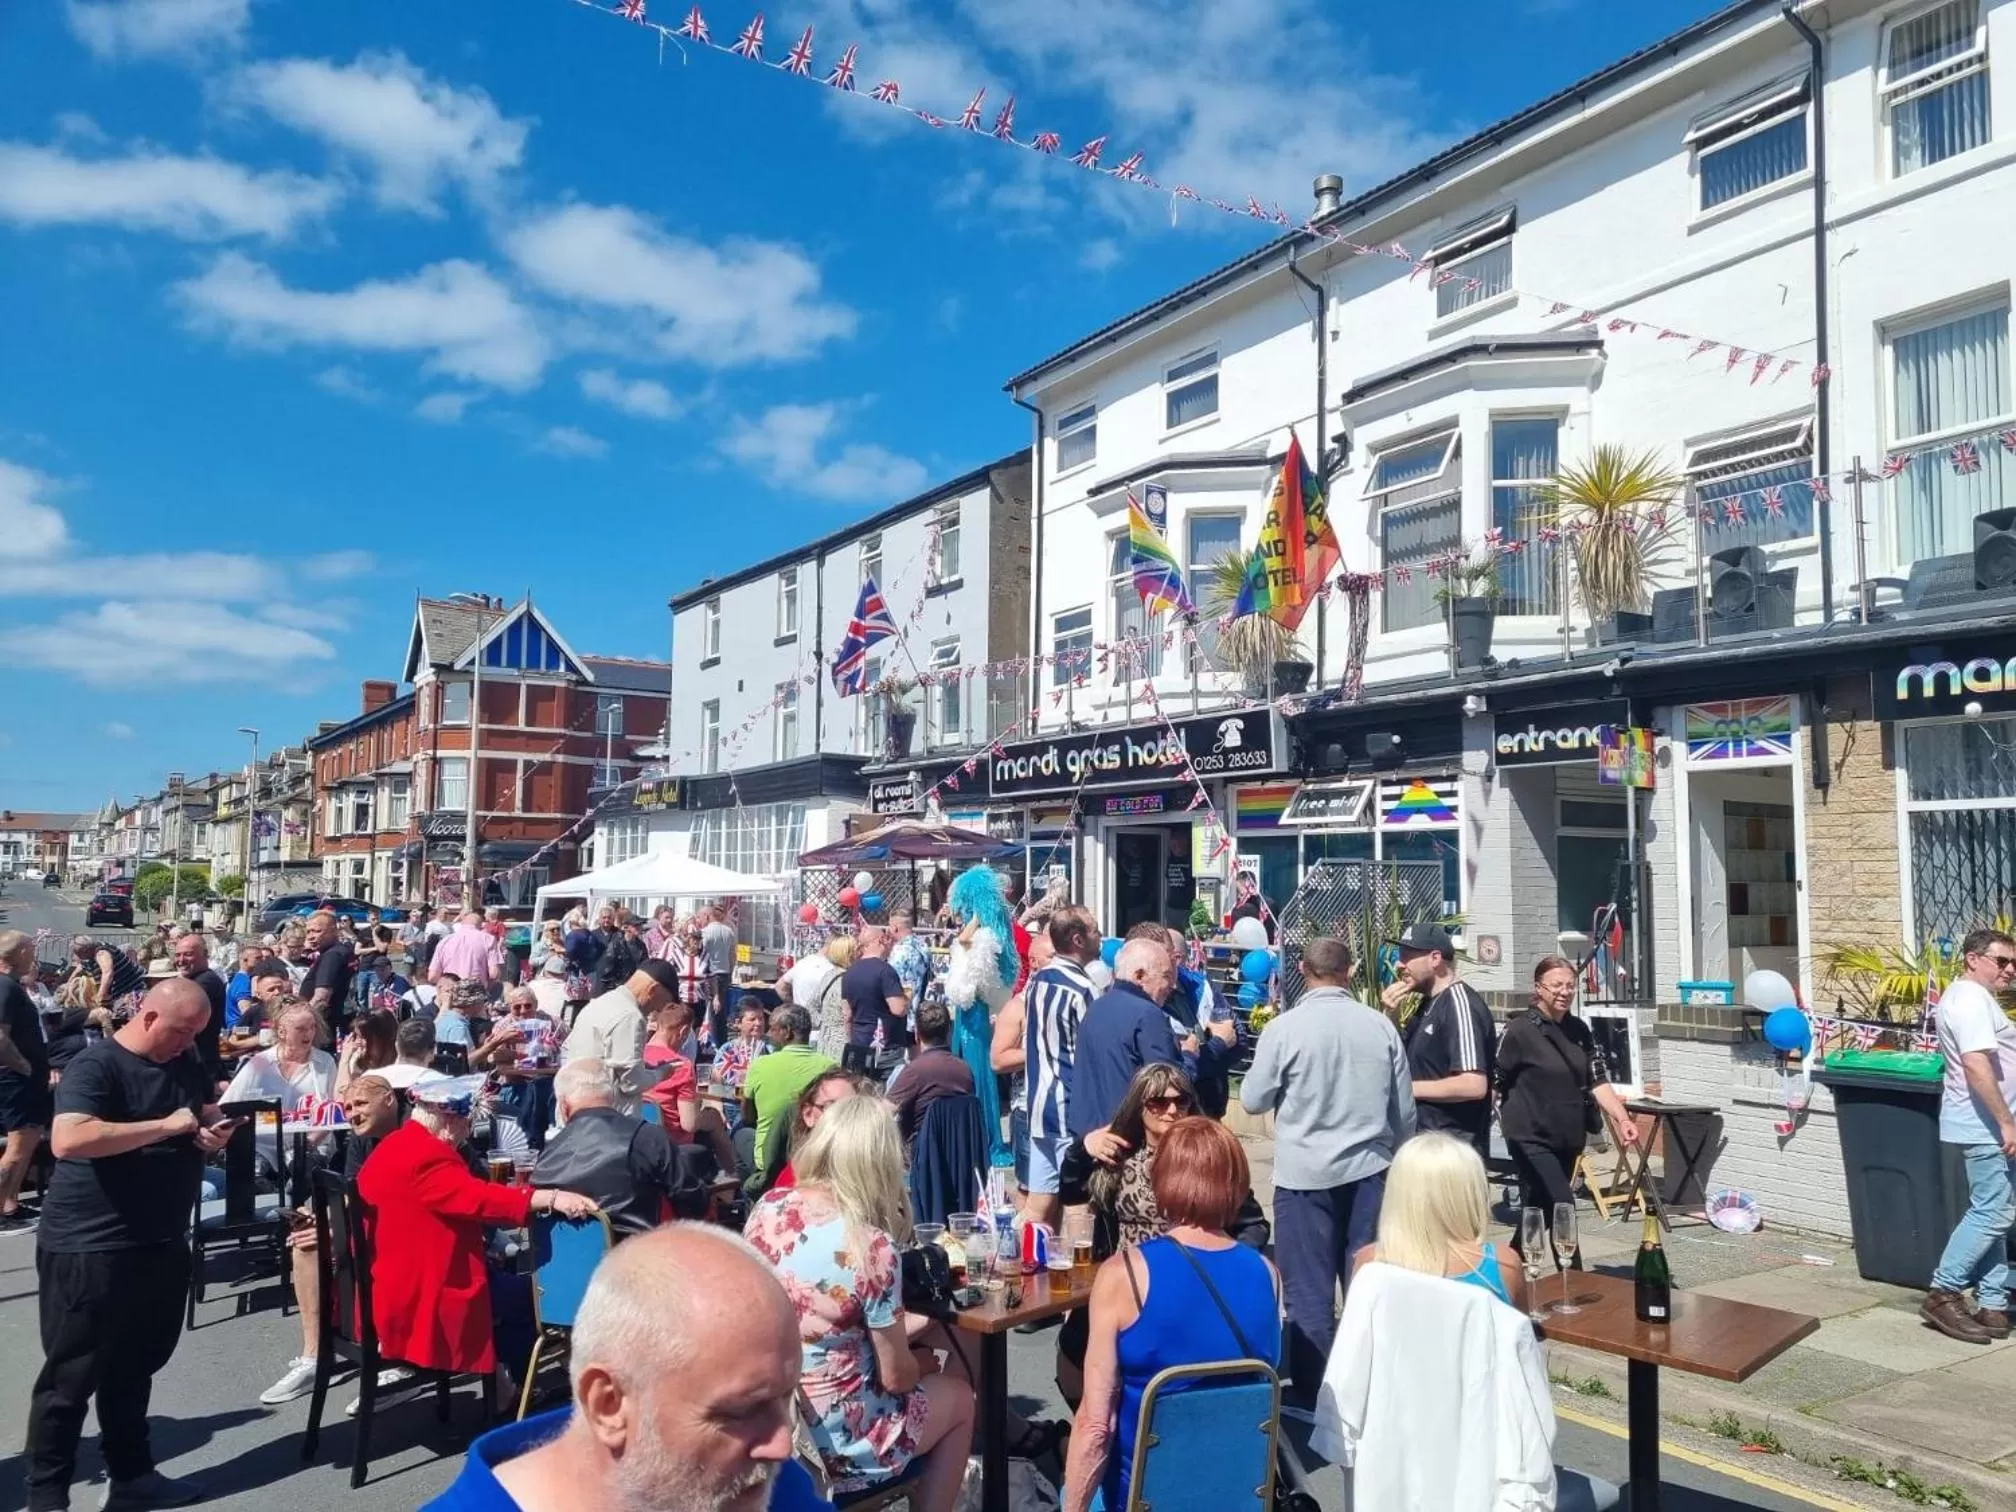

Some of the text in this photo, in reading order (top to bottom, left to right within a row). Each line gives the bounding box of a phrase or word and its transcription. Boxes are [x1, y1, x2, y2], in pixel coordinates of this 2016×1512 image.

[1252, 567, 1302, 590] OTEL
[1497, 724, 1602, 754] entranc
[996, 745, 1060, 781] mardi
[1066, 744, 1120, 783] gras
[1194, 750, 1267, 771] 01253 283633
[885, 783, 912, 798] rooms
[1298, 799, 1326, 810] free
[420, 819, 468, 835] Moore
